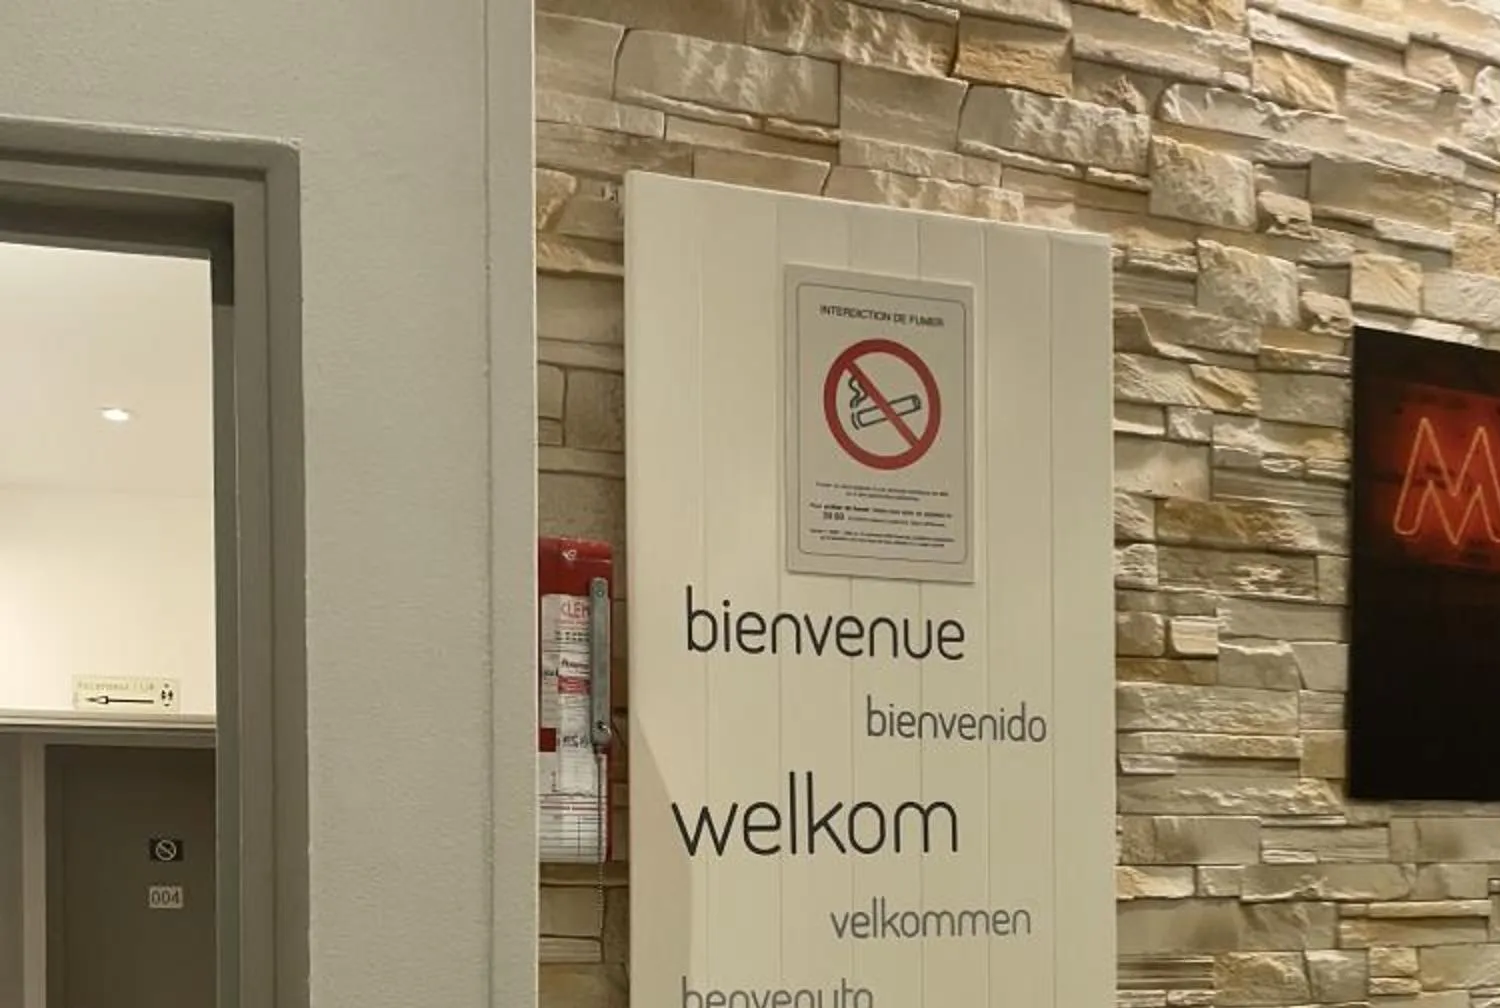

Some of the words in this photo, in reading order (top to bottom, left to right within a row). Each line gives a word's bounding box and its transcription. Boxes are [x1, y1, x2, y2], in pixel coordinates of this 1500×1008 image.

[820, 304, 891, 321] INTERDICTION
[893, 312, 907, 325] DE
[909, 314, 945, 327] FUMER
[685, 584, 965, 660] bienvenue
[866, 694, 1048, 743] bienvenido
[671, 771, 958, 857] welkom
[151, 889, 180, 906] 004
[829, 896, 1032, 939] velkommen
